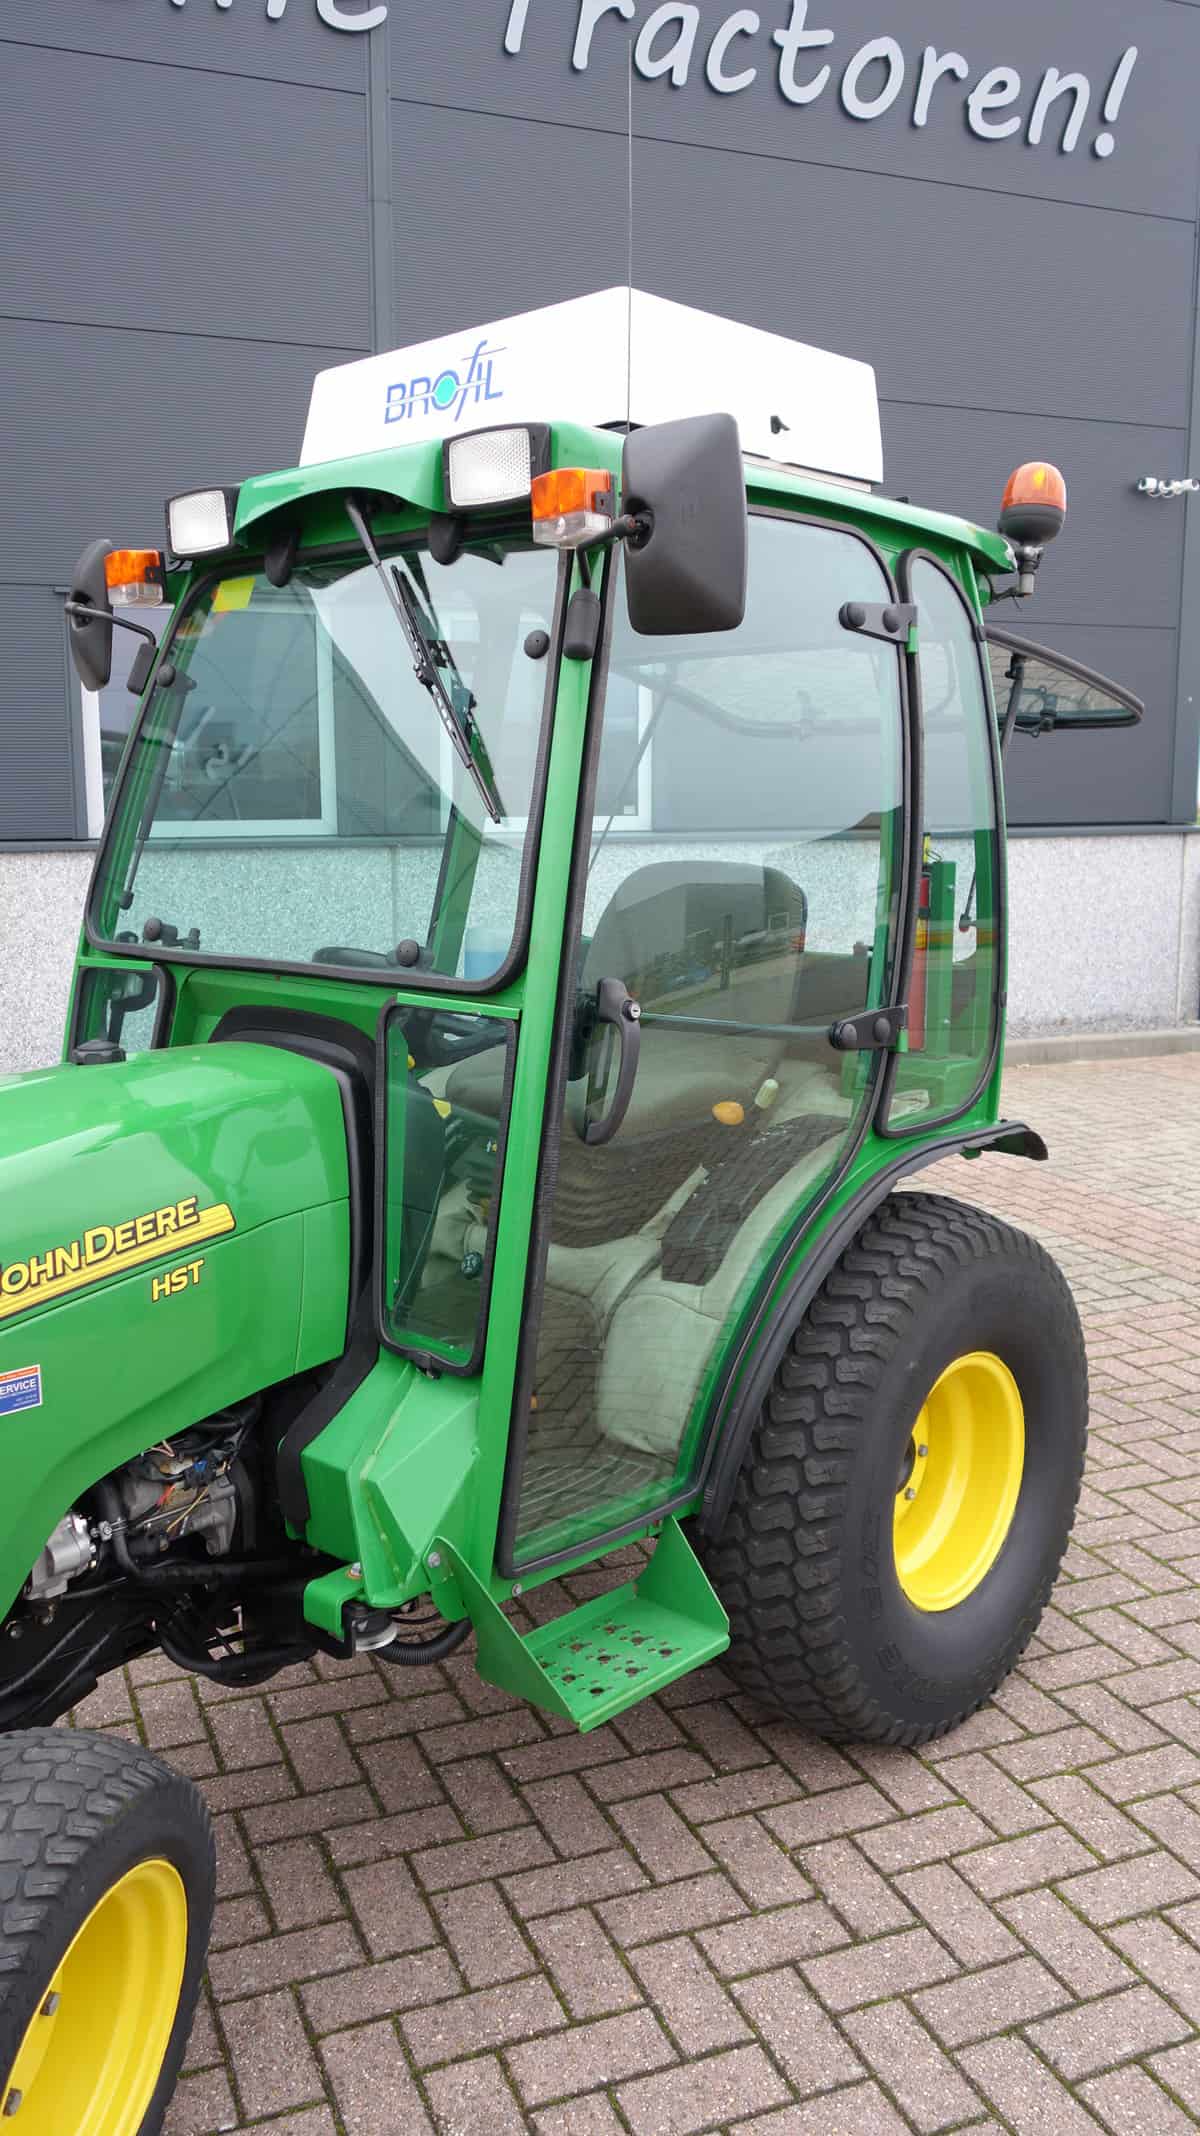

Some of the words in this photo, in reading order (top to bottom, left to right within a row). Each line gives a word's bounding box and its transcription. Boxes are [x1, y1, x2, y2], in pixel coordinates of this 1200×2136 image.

[0, 1241, 81, 1294] OHN
[84, 1196, 199, 1264] DEERE
[151, 1258, 204, 1302] HST
